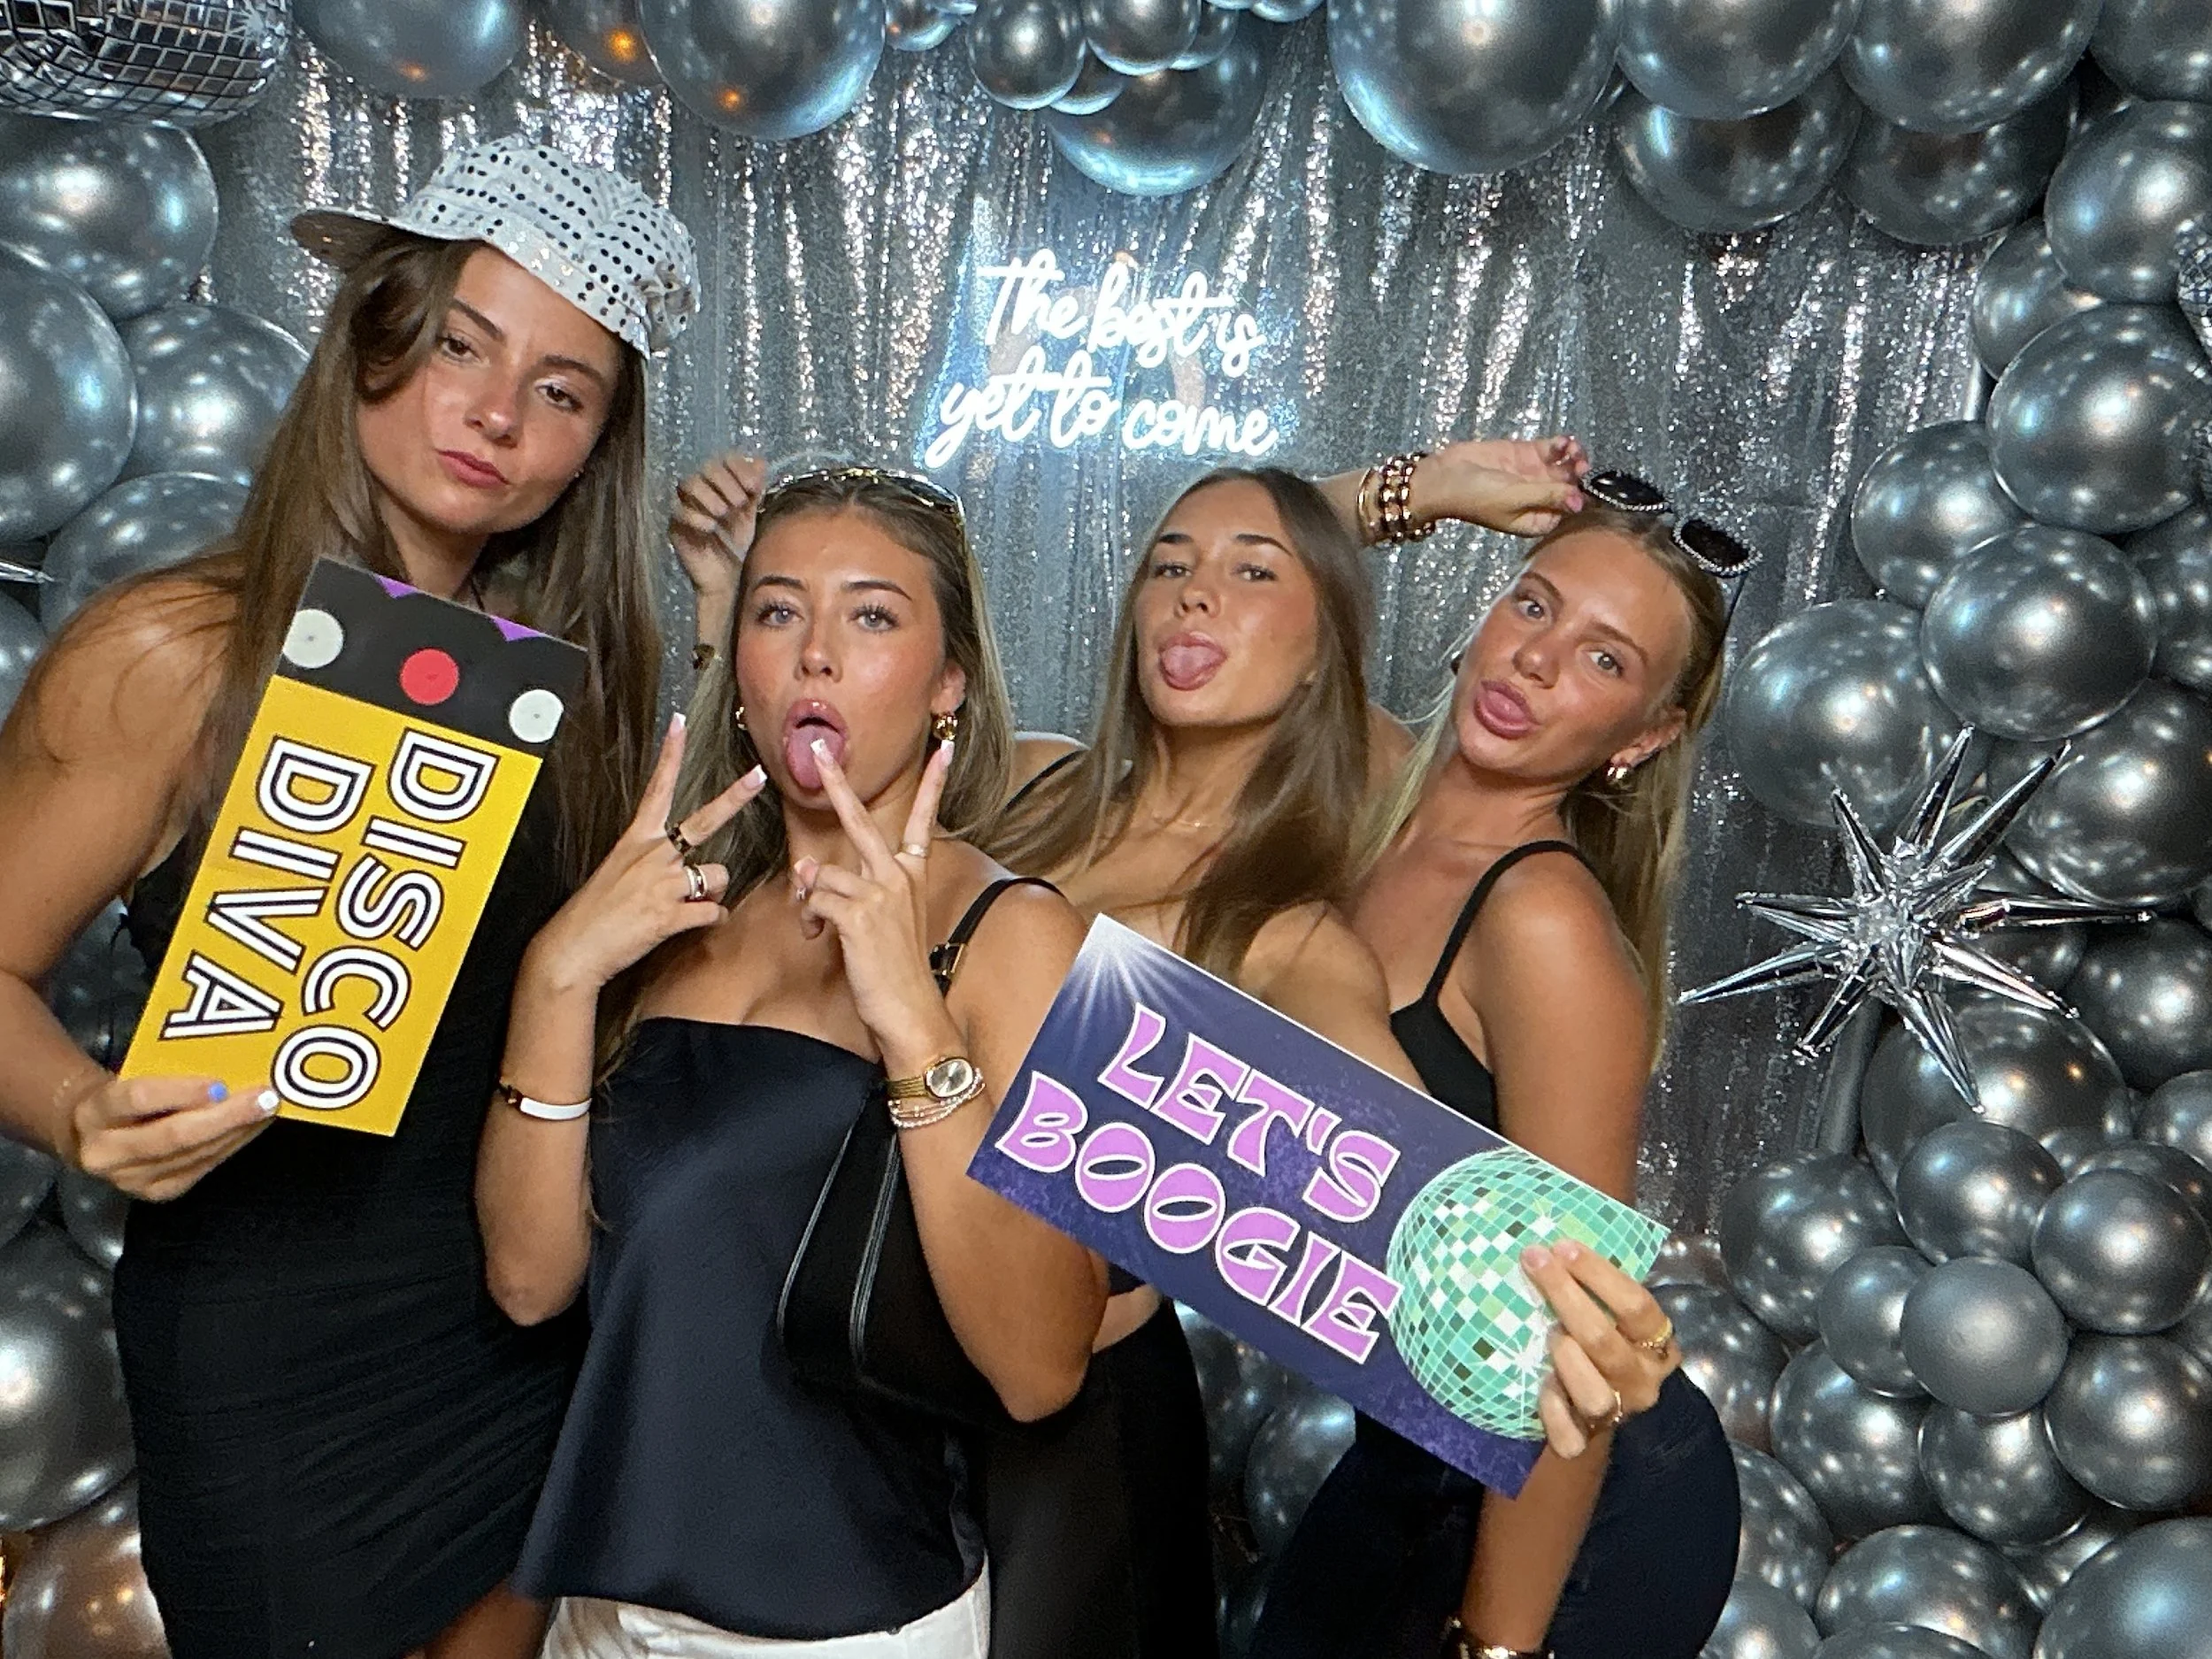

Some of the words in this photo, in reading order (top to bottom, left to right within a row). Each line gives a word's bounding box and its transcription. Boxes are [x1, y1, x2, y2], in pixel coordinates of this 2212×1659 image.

[925, 345, 1064, 470] yet
[1049, 349, 1120, 449] to
[1122, 399, 1279, 456] come
[975, 249, 1087, 345] The
[1087, 261, 1236, 368] best
[1213, 312, 1267, 378] is
[159, 735, 377, 1041] DIVA
[273, 727, 500, 1111] DISCO
[995, 1071, 1405, 1365] BOOGIE
[1097, 1002, 1402, 1225] LET'S
